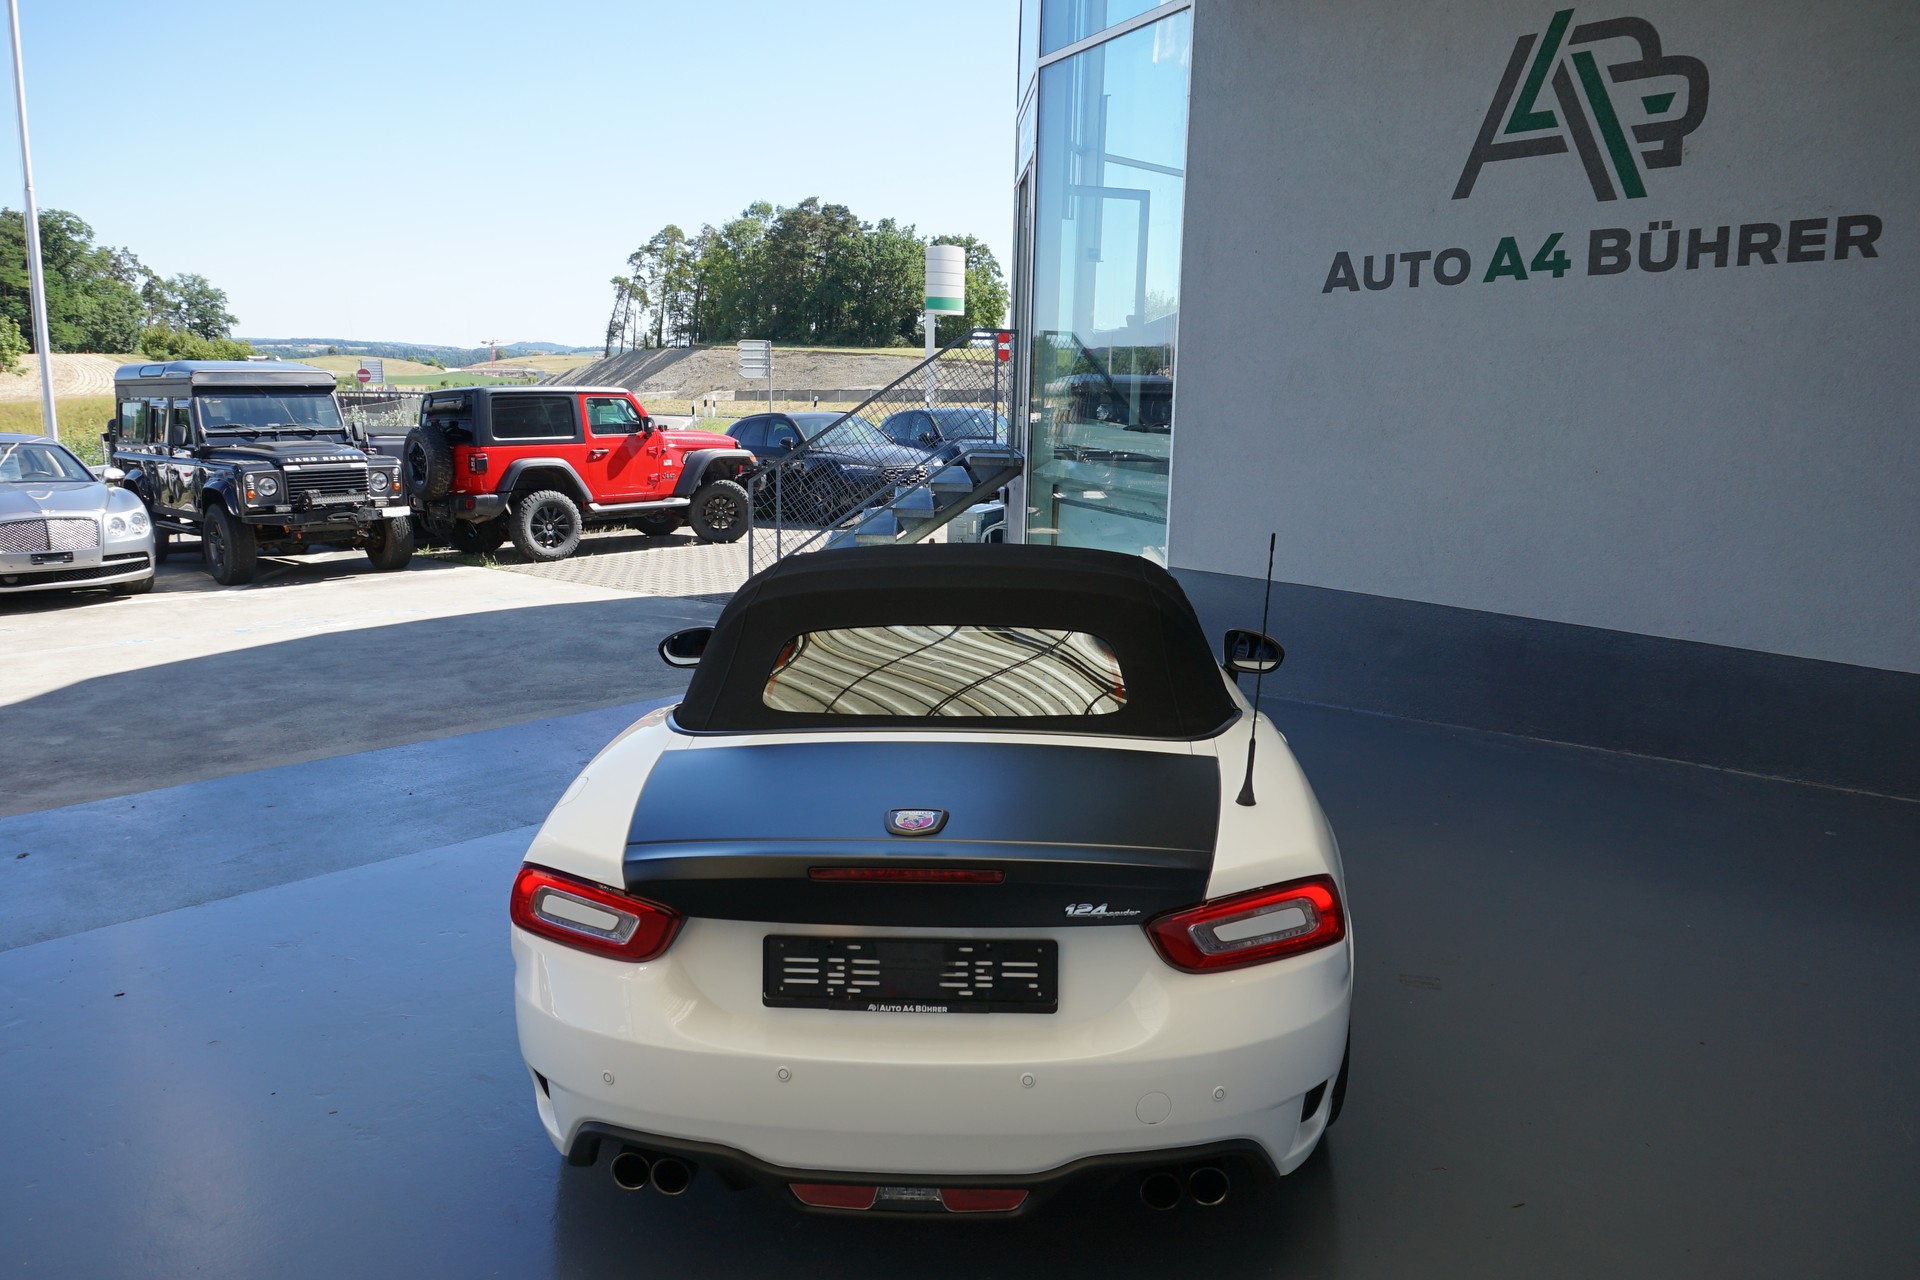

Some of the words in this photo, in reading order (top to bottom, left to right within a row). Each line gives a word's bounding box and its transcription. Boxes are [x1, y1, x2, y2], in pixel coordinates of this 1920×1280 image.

[1322, 248, 1472, 294] AUTO
[1482, 232, 1572, 283] A4
[1587, 213, 1884, 277] BÜHRER
[1065, 903, 1109, 918] 124
[880, 1004, 902, 1012] AUTO
[903, 1004, 914, 1012] A4
[915, 1004, 948, 1013] BÜHRER
